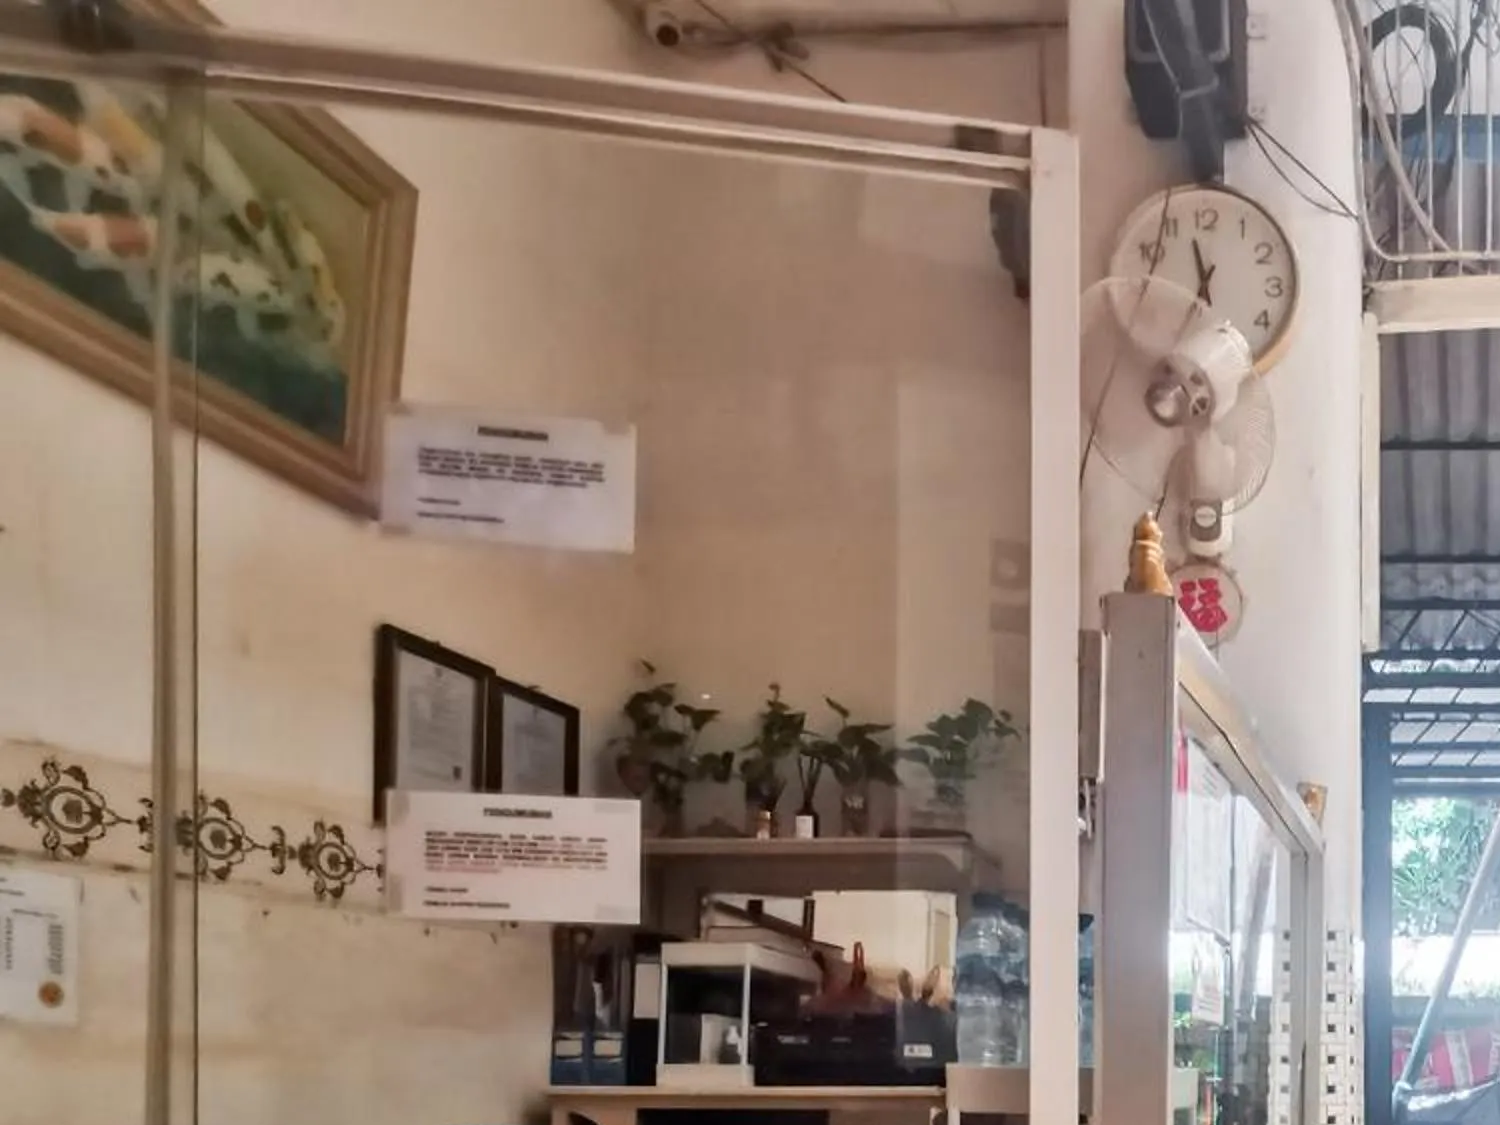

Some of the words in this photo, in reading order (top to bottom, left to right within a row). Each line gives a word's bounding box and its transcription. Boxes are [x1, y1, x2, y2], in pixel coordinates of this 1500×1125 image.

[1194, 208, 1219, 232] 12
[1239, 216, 1246, 240] 1
[1254, 242, 1274, 265] 2
[1264, 276, 1284, 299] 3
[1253, 309, 1271, 332] 4
